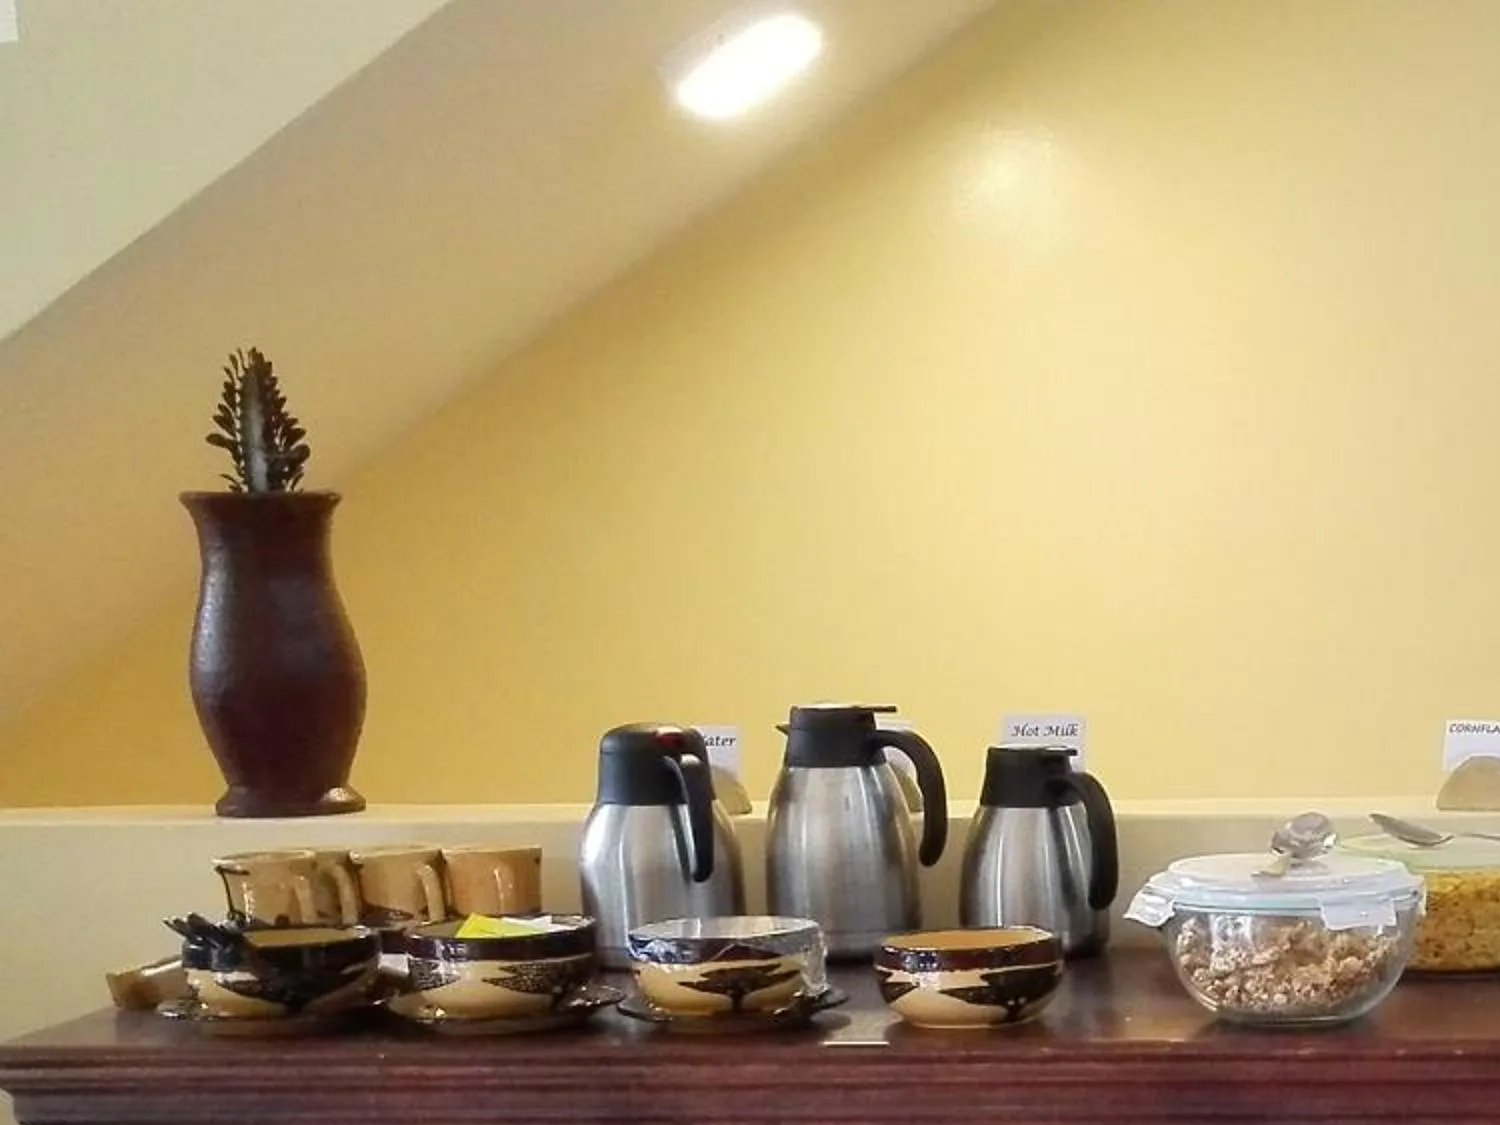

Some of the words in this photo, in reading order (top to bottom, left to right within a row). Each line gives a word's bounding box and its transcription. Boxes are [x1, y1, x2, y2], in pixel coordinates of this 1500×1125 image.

[1010, 722, 1039, 736] Hot
[1042, 722, 1078, 736] Milk
[704, 735, 736, 747] ater
